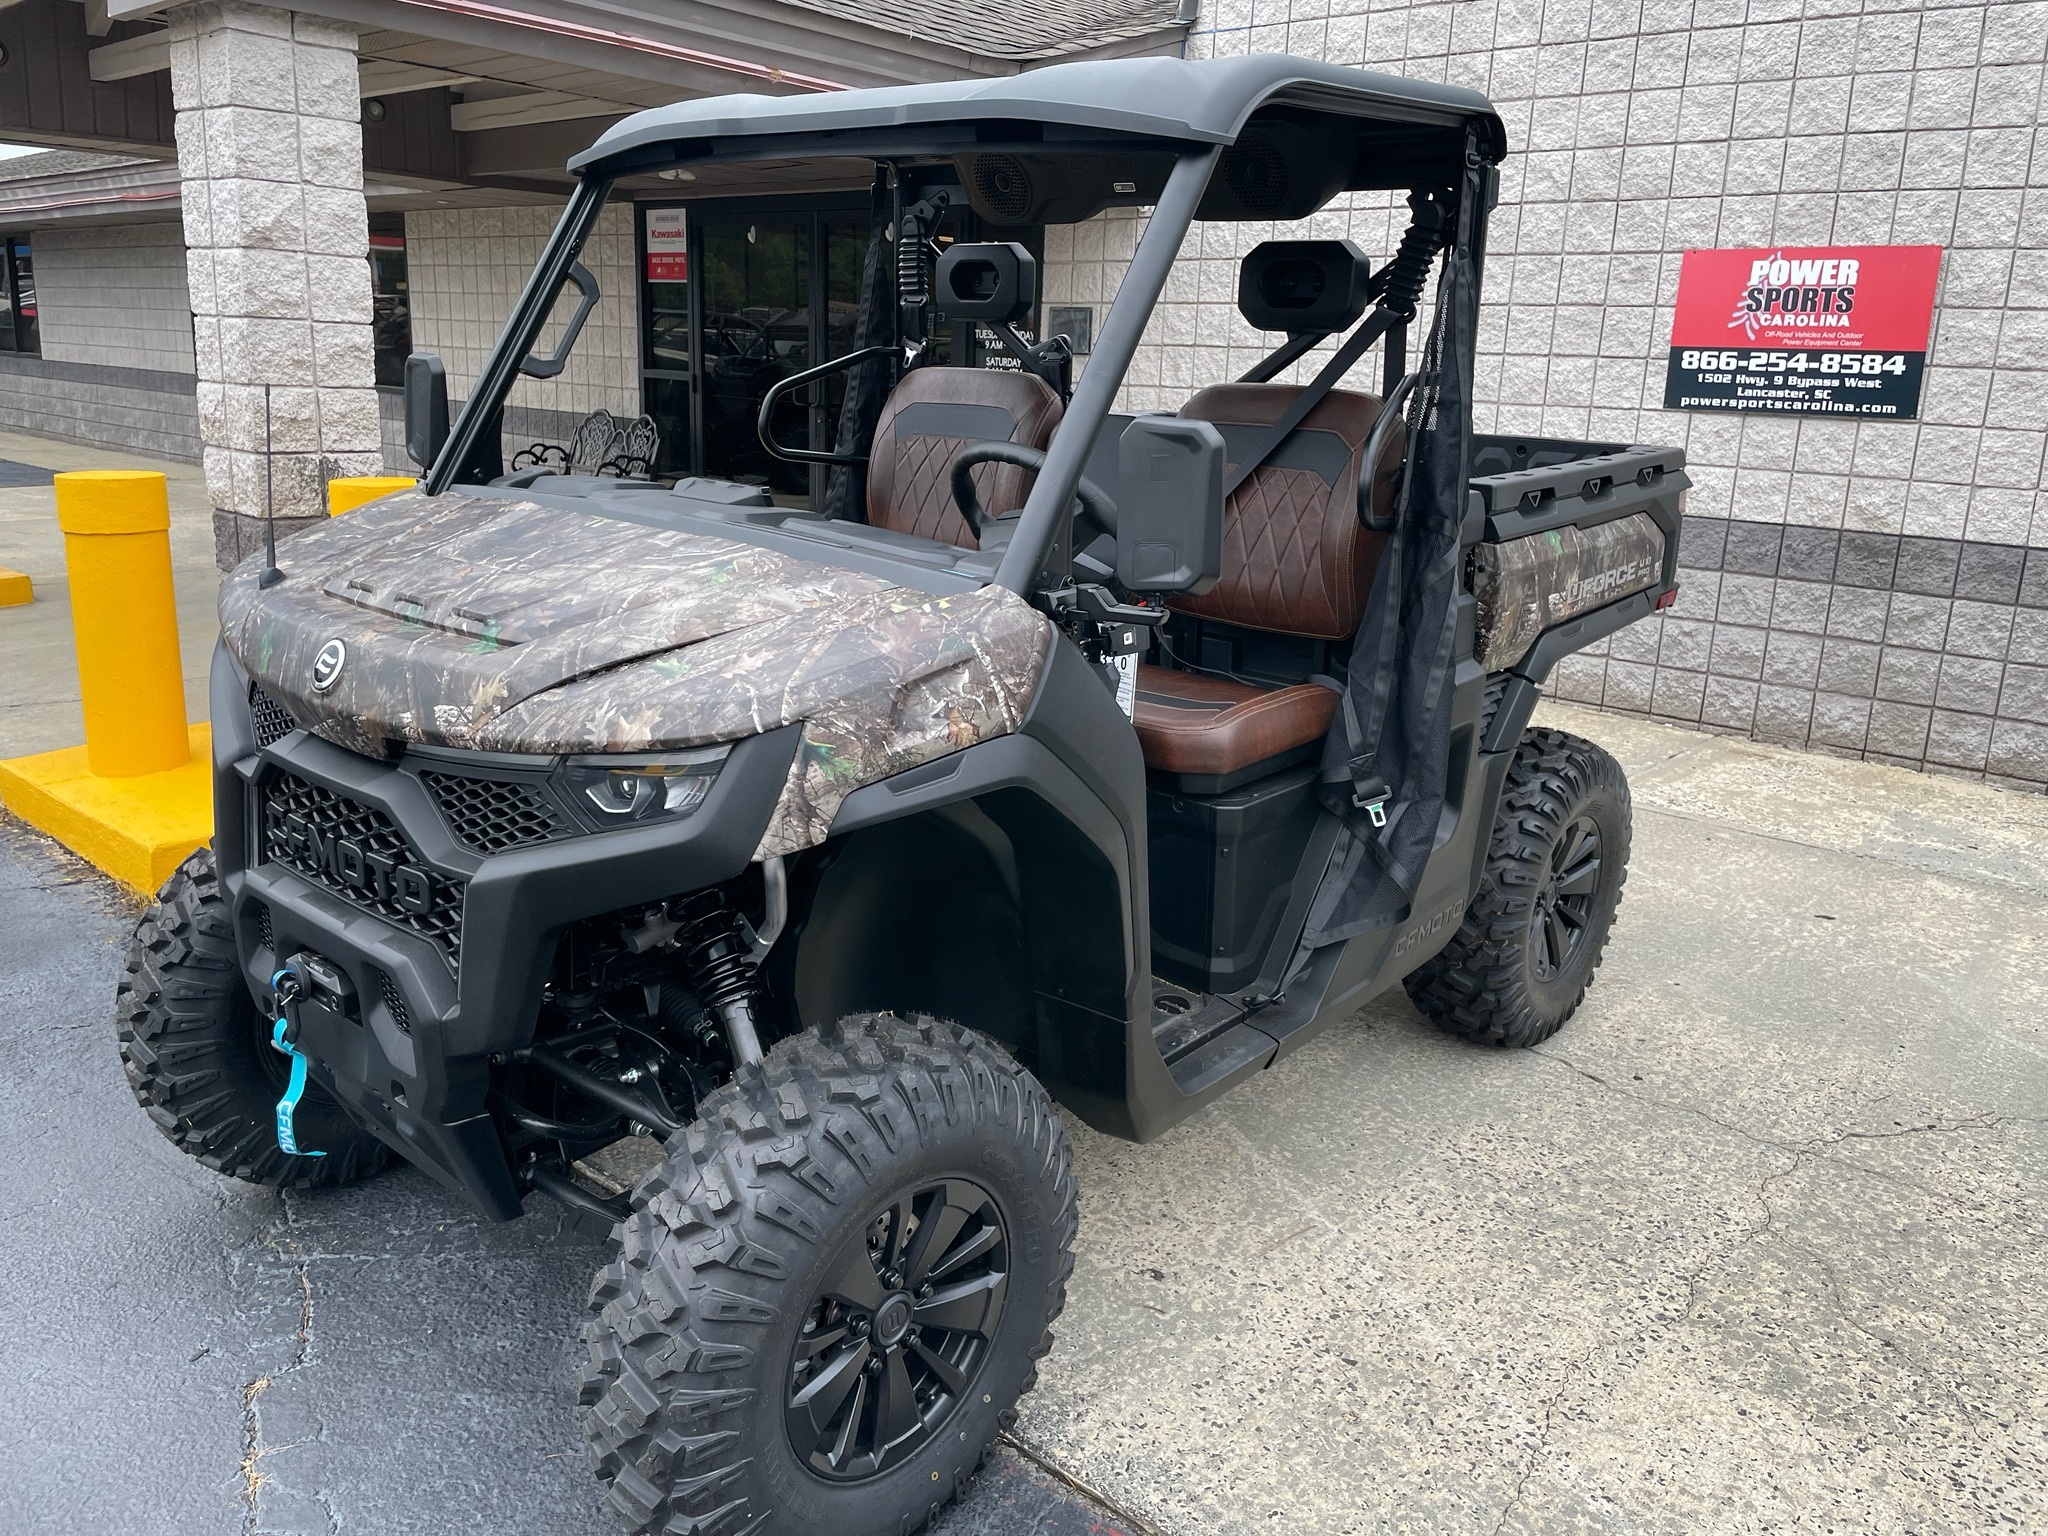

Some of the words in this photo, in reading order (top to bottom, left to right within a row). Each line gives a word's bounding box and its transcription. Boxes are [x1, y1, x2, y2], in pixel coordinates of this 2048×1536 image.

[652, 229, 684, 238] Kawasaki
[1749, 259, 1860, 286] POWER
[1746, 286, 1856, 314] SPORTS
[1759, 314, 1850, 327] CAROLINA
[1764, 330, 1794, 338] Off-Road
[1794, 331, 1821, 339] Vehicles
[1821, 331, 1837, 339] And
[985, 340, 990, 348] 9
[990, 340, 1003, 350] AM
[1782, 338, 1803, 346] Power
[1803, 338, 1839, 347] Equipment
[1839, 339, 1863, 347] Center
[986, 357, 1021, 367] SATURDAY
[1680, 350, 1906, 376] 866-254-8584
[1697, 373, 1732, 384] 1502
[1736, 373, 1769, 388] Hwy.
[1773, 375, 1784, 386] 9
[1787, 376, 1840, 390] Bypass
[1844, 377, 1883, 389] West
[1737, 387, 1810, 399] Lancaster,
[1814, 389, 1832, 400] SC
[1680, 396, 1897, 414] powersportscarolina.com
[266, 800, 432, 915] CFMOTO
[1395, 898, 1465, 958] CFMOTO
